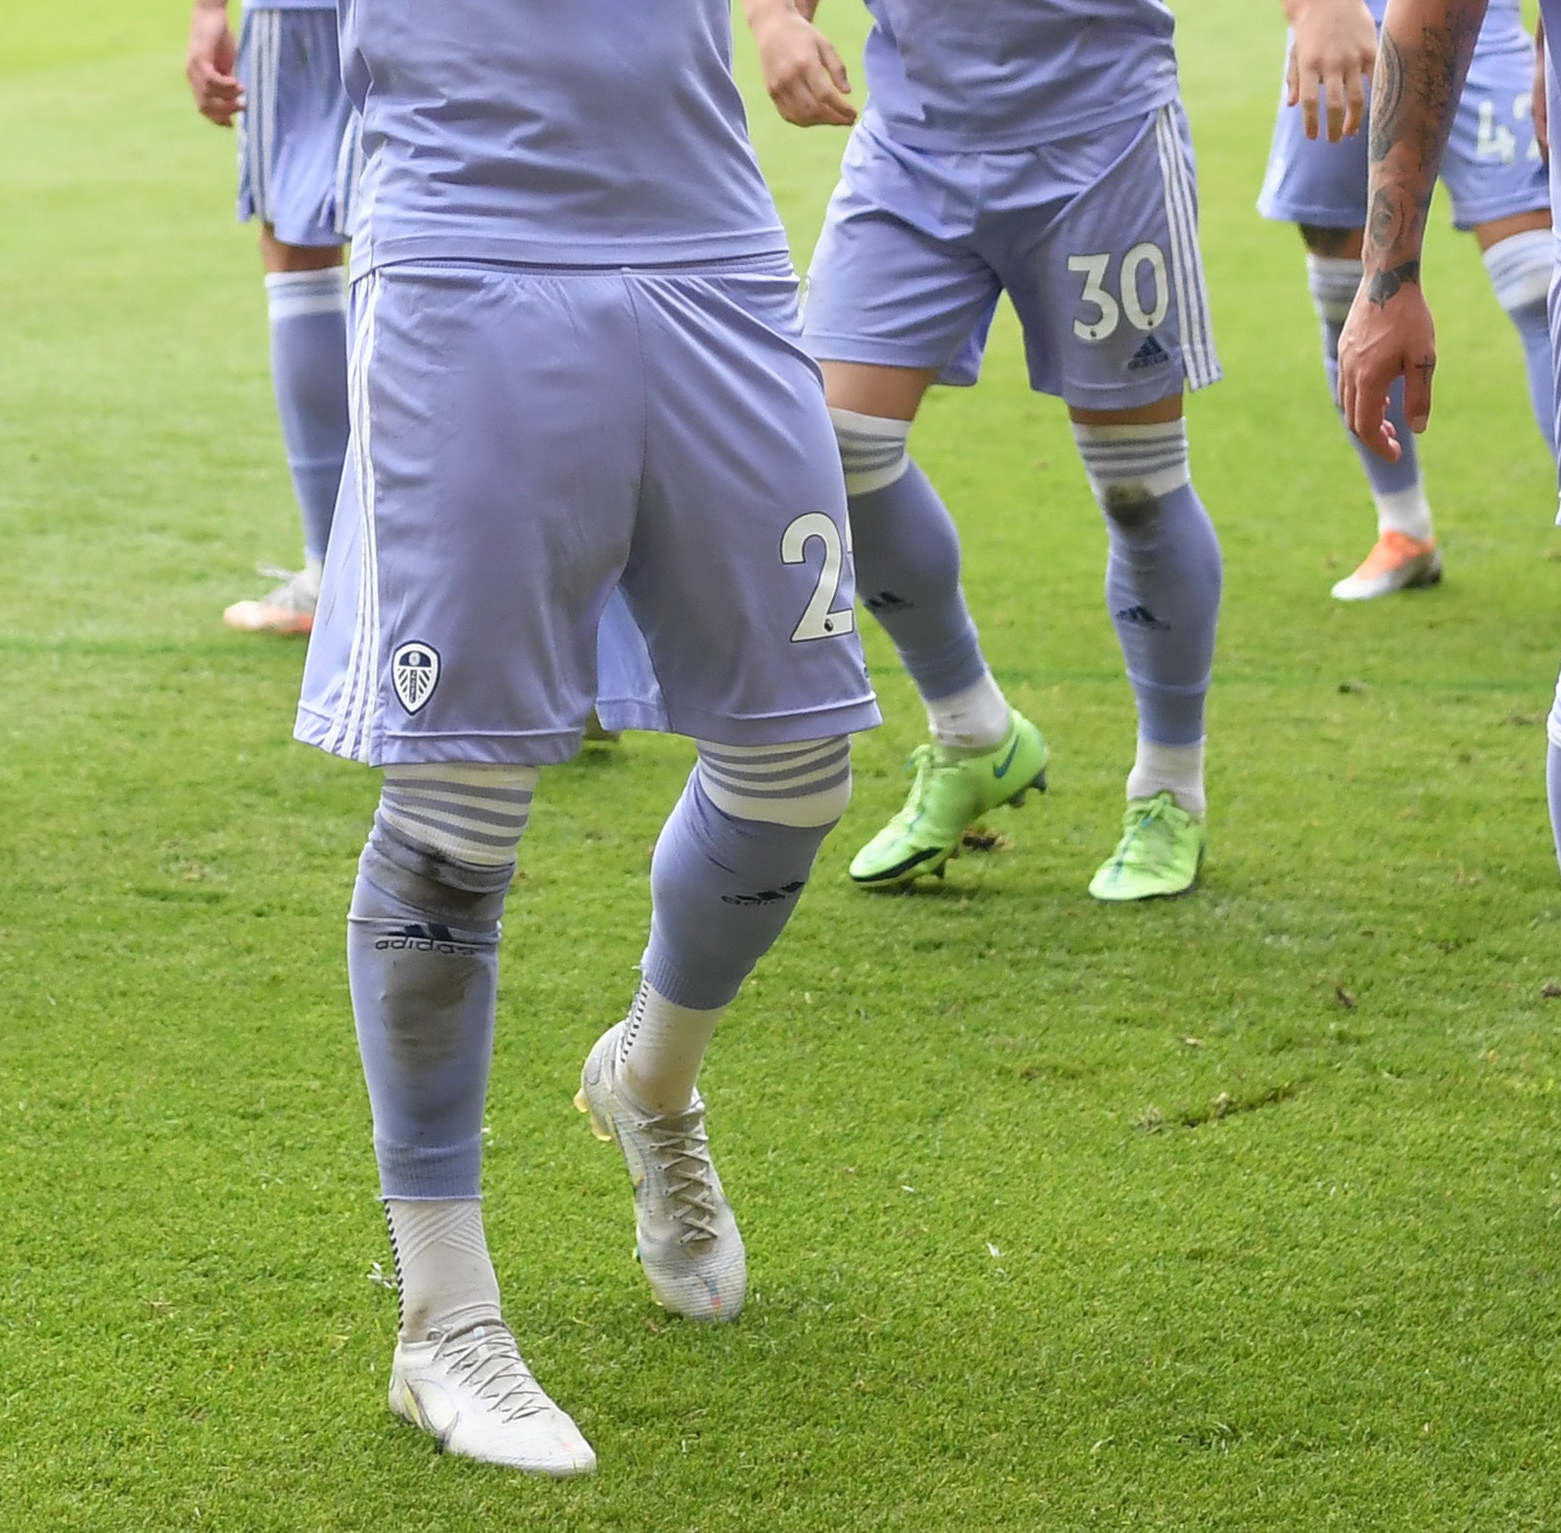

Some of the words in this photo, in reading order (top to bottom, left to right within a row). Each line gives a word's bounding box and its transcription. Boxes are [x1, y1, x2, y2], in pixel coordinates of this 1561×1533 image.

[1067, 242, 1169, 342] 30
[779, 510, 854, 644] 2
[374, 936, 476, 956] adidas
